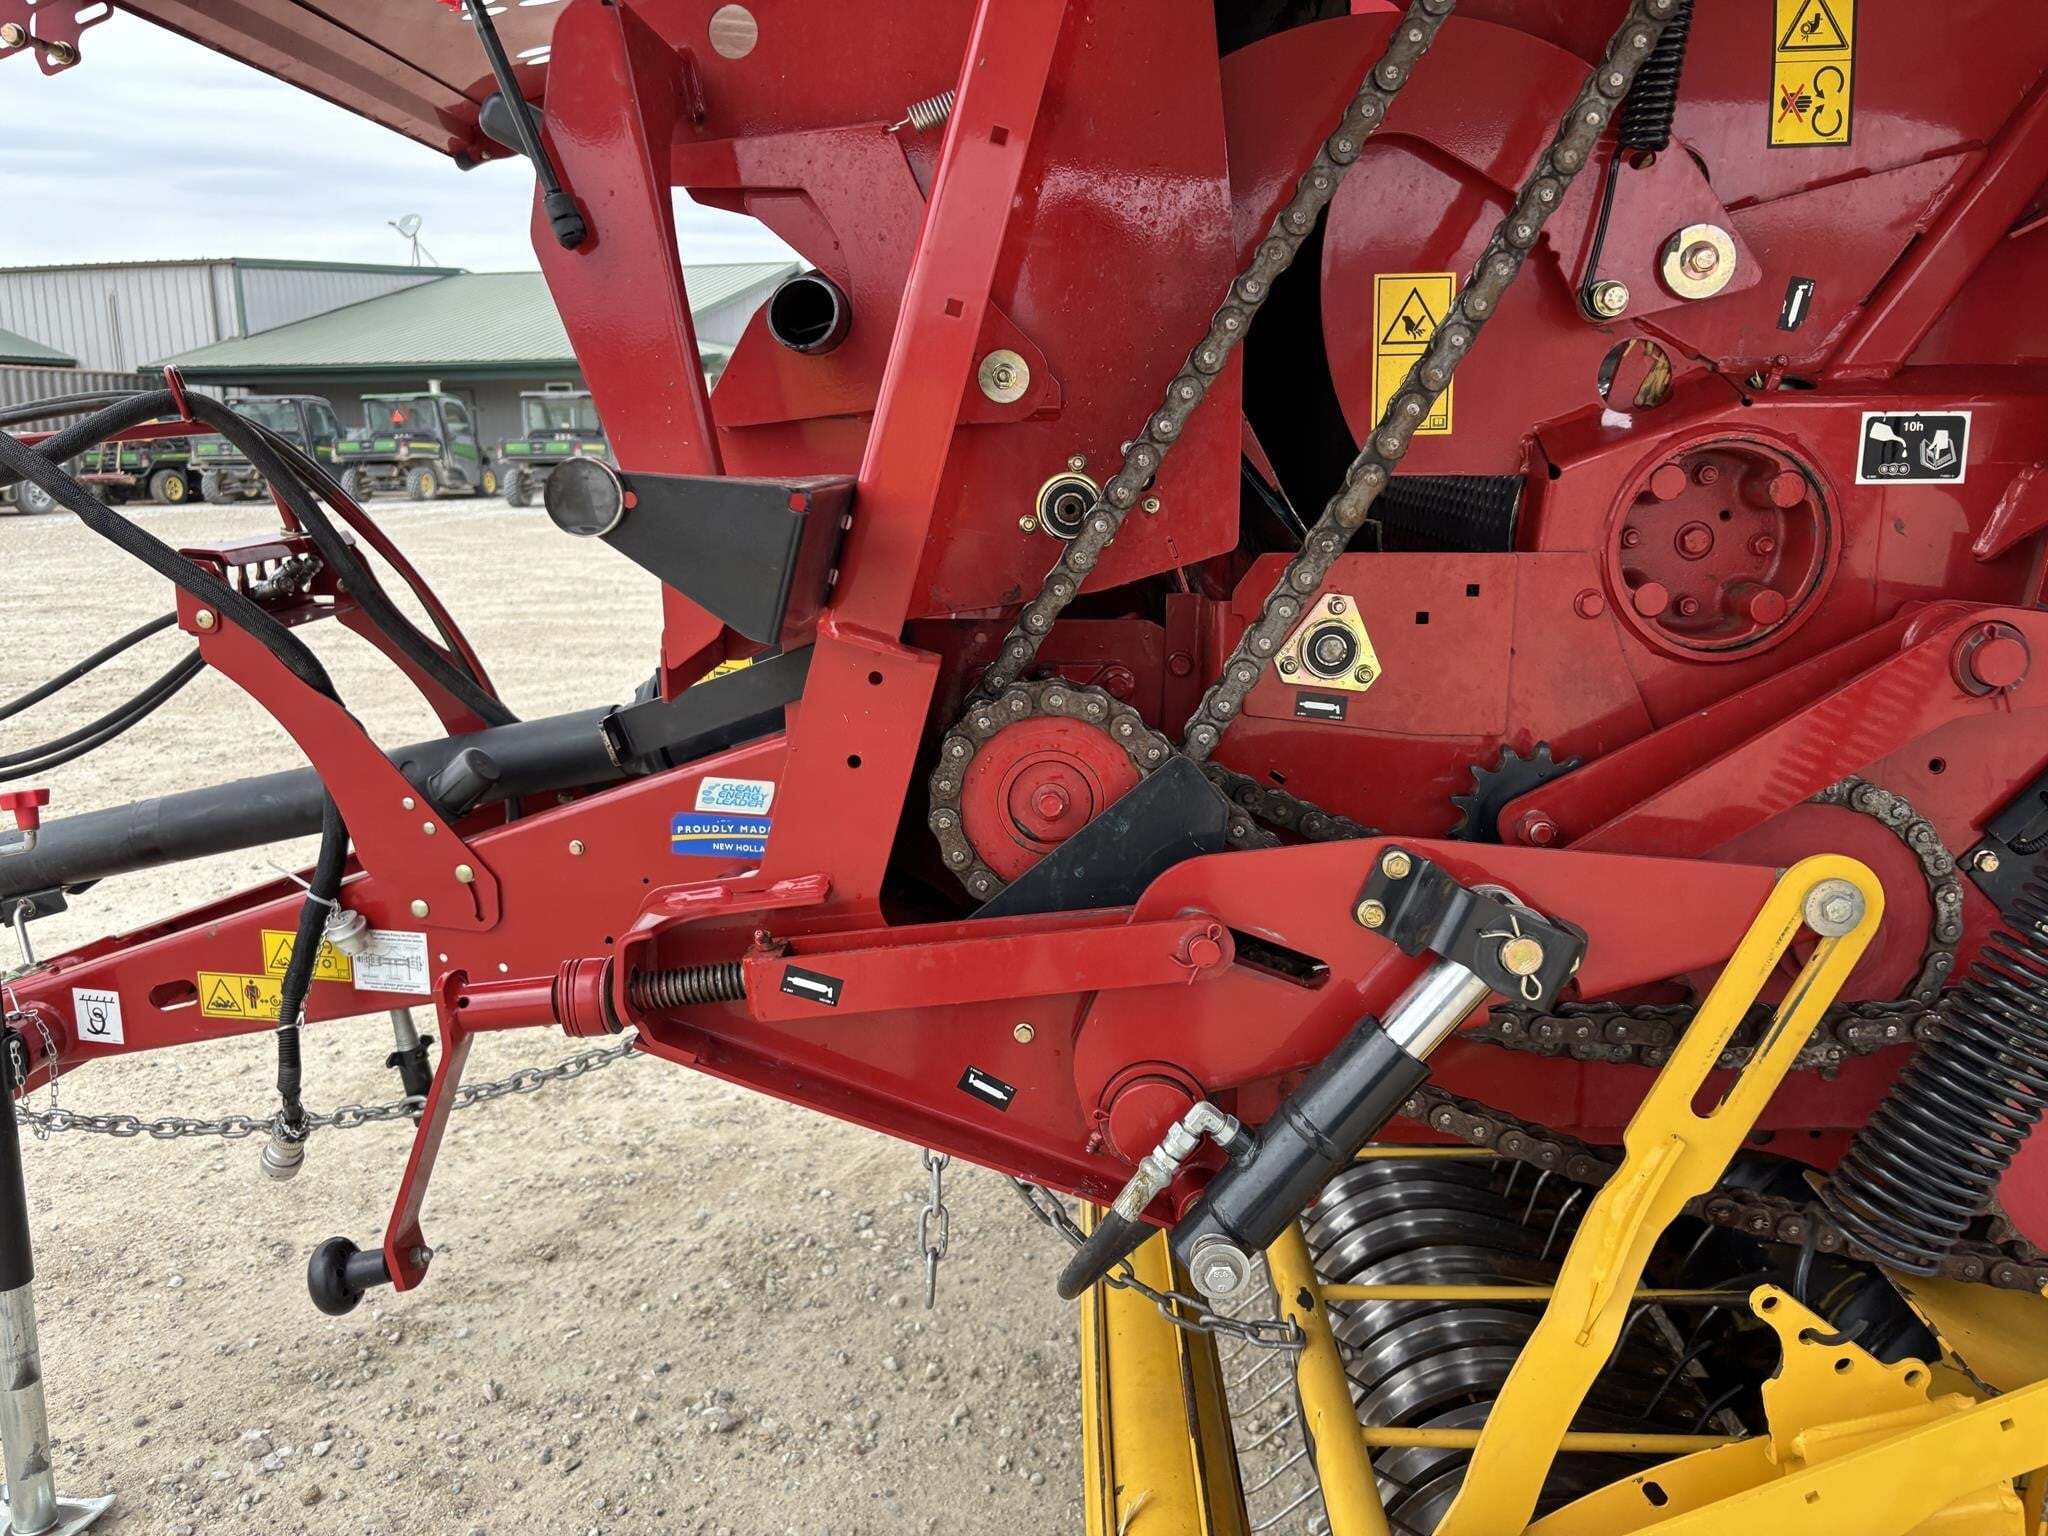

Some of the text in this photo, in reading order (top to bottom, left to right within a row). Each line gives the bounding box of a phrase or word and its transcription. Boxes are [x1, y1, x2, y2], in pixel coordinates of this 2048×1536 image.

[1903, 421, 1924, 432] 10h
[721, 783, 762, 793] CLEAN
[718, 790, 769, 801] ENERGY
[715, 798, 765, 808] LEADER
[677, 825, 771, 834] PROUDLY MAD
[712, 842, 734, 851] NEW
